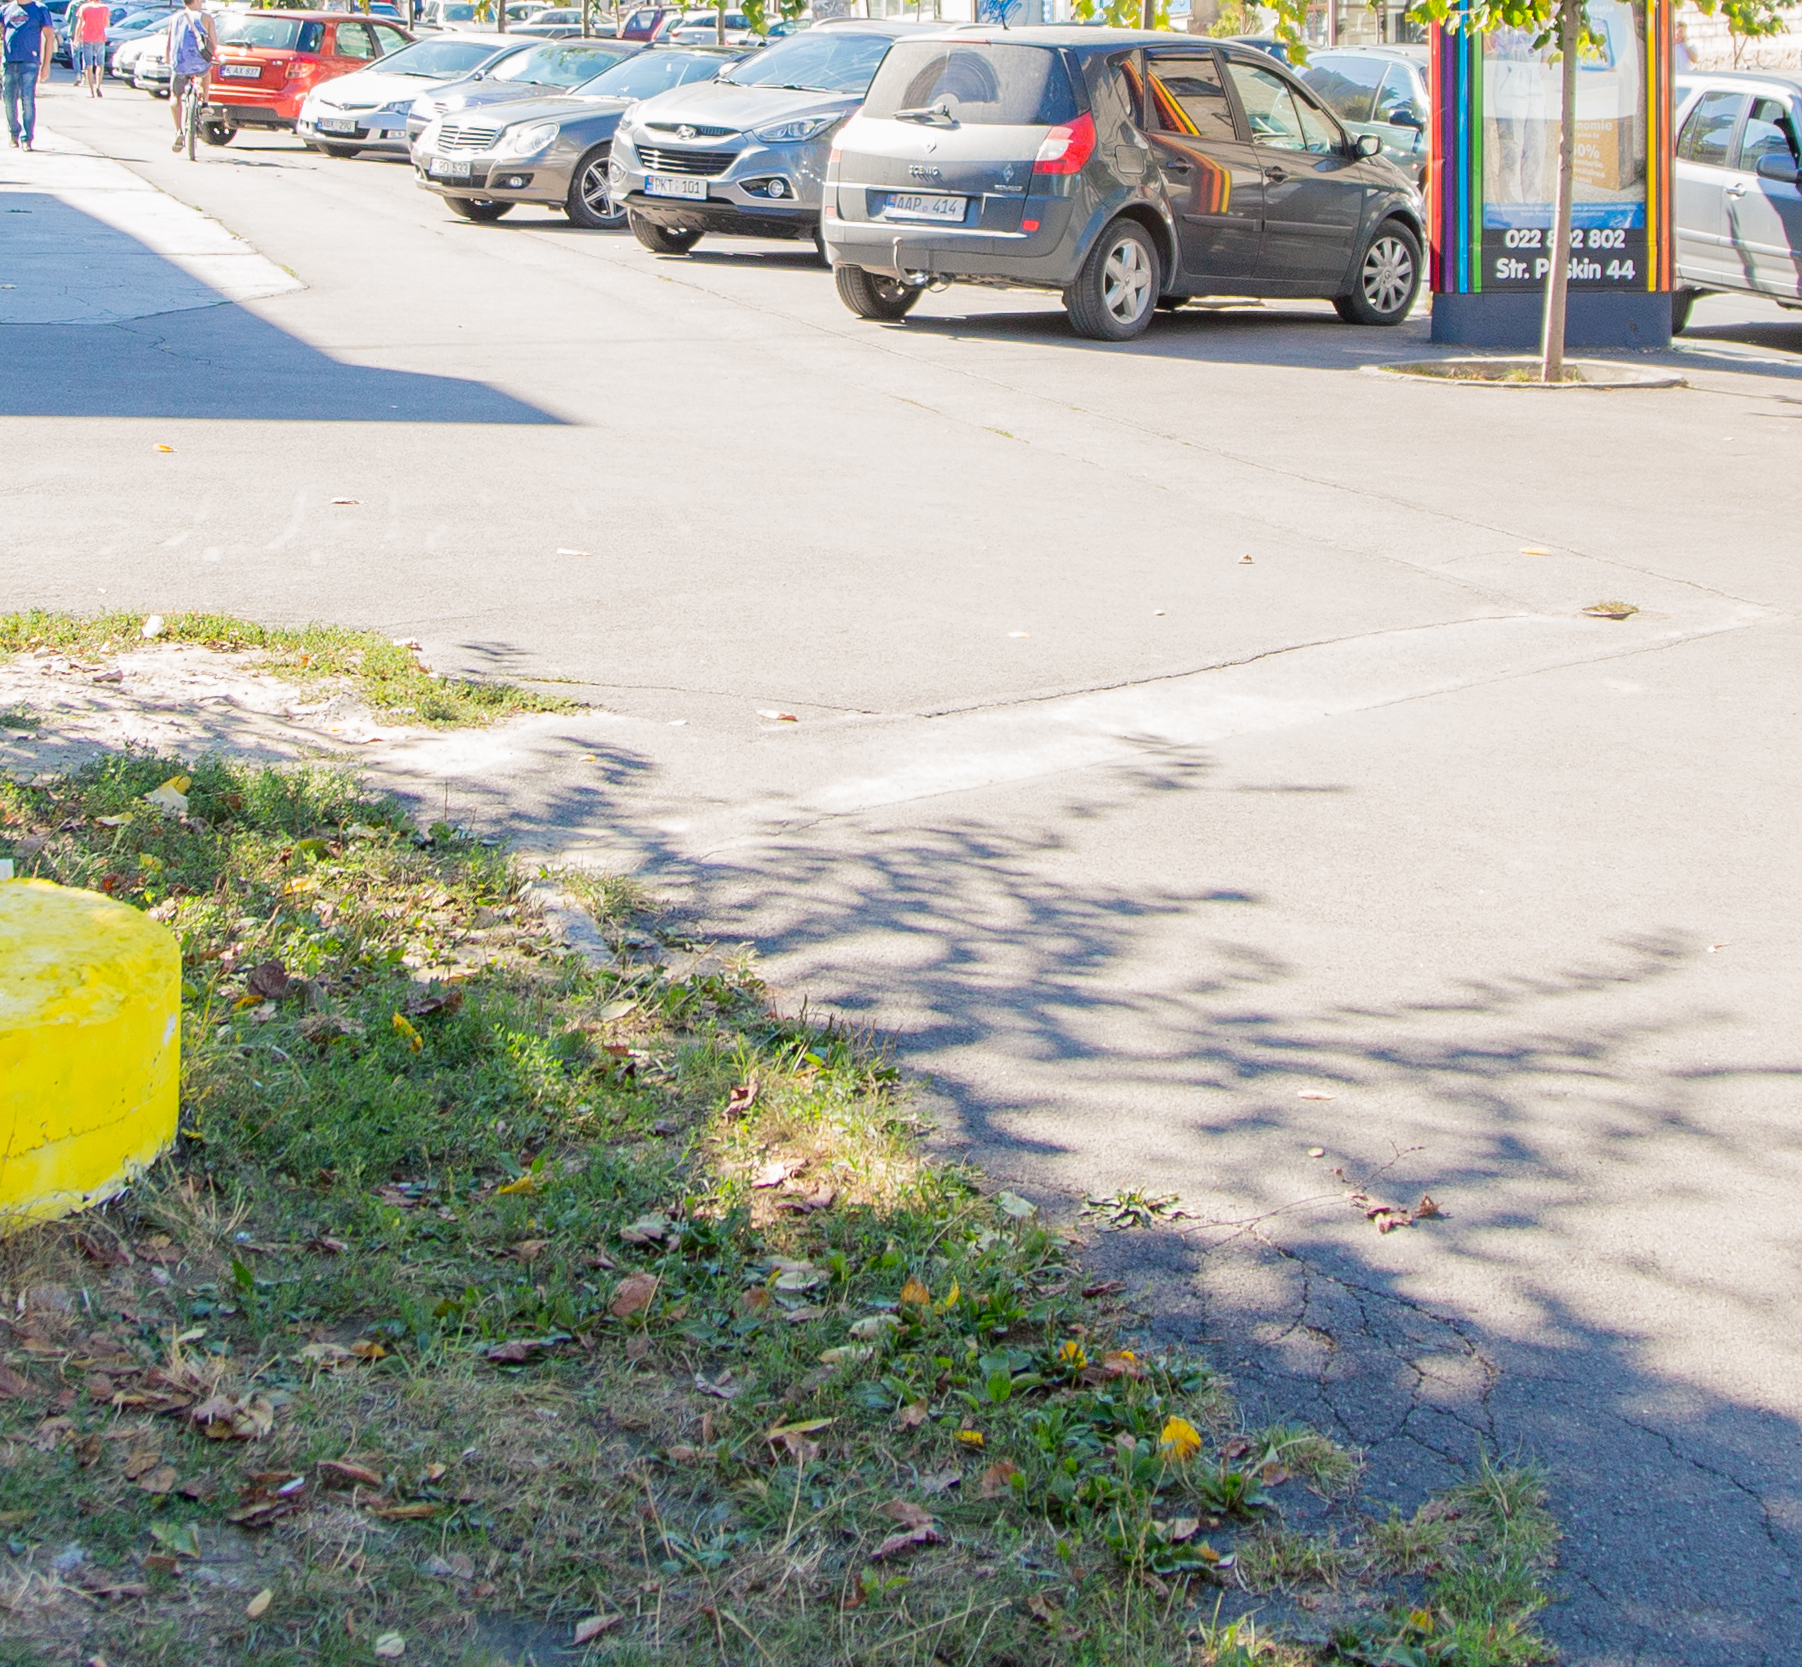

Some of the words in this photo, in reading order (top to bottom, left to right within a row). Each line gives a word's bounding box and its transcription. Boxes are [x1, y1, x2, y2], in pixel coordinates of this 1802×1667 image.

[655, 177, 674, 193] PKT
[681, 180, 700, 194] 101
[896, 195, 923, 212] AAP
[932, 198, 959, 215] 414
[1505, 228, 1542, 249] 022
[1588, 228, 1626, 249] 802
[1496, 257, 1531, 279] Str.
[1535, 257, 1602, 280] Pskin
[1606, 259, 1636, 280] 44
